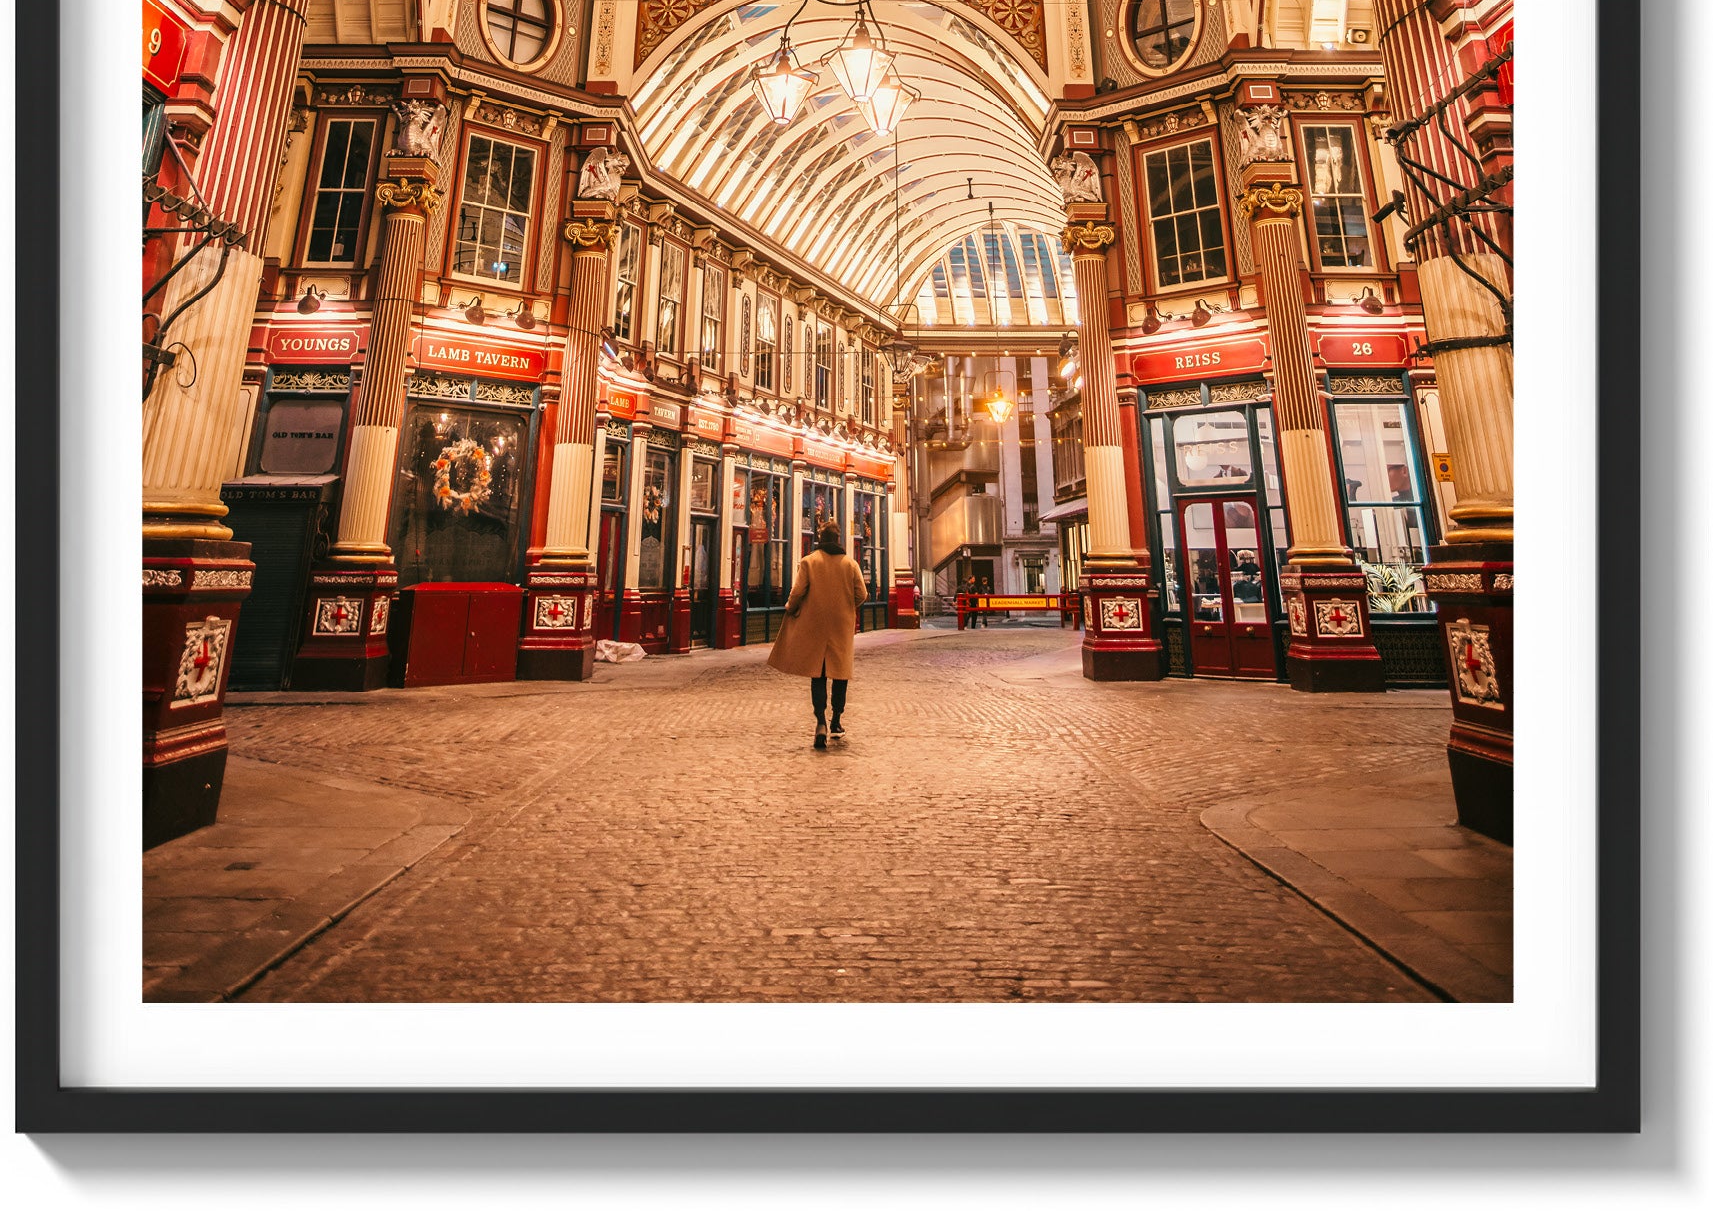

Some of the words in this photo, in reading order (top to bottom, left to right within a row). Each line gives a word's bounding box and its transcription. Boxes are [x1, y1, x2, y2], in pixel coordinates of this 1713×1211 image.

[148, 28, 162, 56] 9
[280, 338, 350, 351] YOUNGS
[1352, 342, 1372, 355] 26
[427, 345, 470, 361] LAMB
[475, 351, 530, 369] TAVERN
[1175, 352, 1222, 369] REISS
[610, 396, 630, 409] LAMB
[654, 406, 676, 420] TAVERN
[1183, 441, 1239, 457] REISS
[220, 491, 243, 499] OLD
[249, 491, 286, 499] TOM'S
[291, 491, 316, 499] BAR
